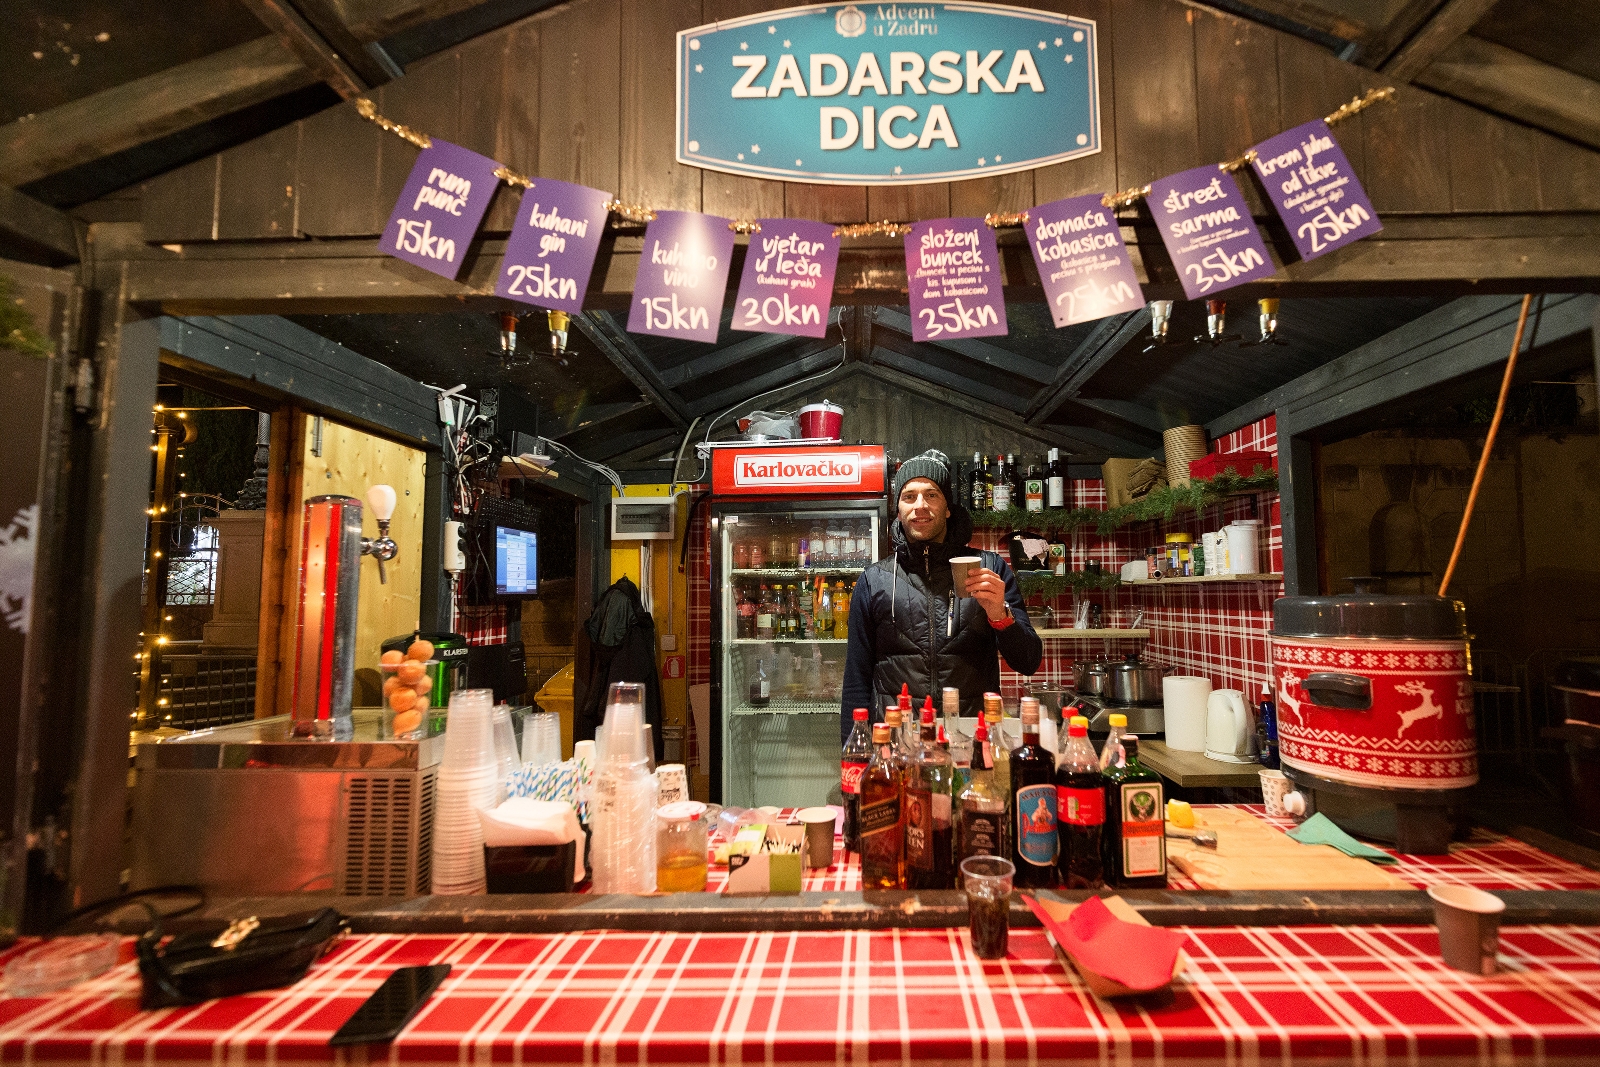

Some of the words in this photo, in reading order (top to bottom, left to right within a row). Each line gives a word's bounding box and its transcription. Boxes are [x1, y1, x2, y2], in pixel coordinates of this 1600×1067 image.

[874, 4, 935, 20] Advent
[873, 25, 883, 36] u
[888, 20, 938, 36] Zadru
[731, 50, 1045, 98] ZADARSKA
[820, 105, 959, 150] DICA
[1255, 148, 1303, 177] krem
[1301, 134, 1335, 168] juha
[427, 167, 471, 196] rum
[1281, 171, 1303, 195] od
[1299, 161, 1339, 186] tikve
[413, 186, 468, 216] punč
[1163, 177, 1227, 214] street
[530, 203, 589, 238] kuhani
[1035, 210, 1108, 241] domaća
[1170, 206, 1241, 238] sarma
[1298, 204, 1371, 253] 25kn
[395, 218, 455, 262] 15kn
[538, 234, 566, 258] gin
[763, 232, 825, 259] vjetar
[921, 227, 980, 249] složeni
[1035, 232, 1118, 263] kobasica
[652, 240, 717, 271] kuho
[755, 258, 768, 273] u
[920, 244, 983, 268] buncek
[1185, 247, 1264, 293] 35kn
[507, 264, 577, 300] 25kn
[664, 268, 699, 288] vino
[641, 293, 709, 330] 15kn
[741, 293, 820, 327] 30kn
[919, 298, 998, 338] 35kn
[743, 460, 853, 477] Karlovačko
